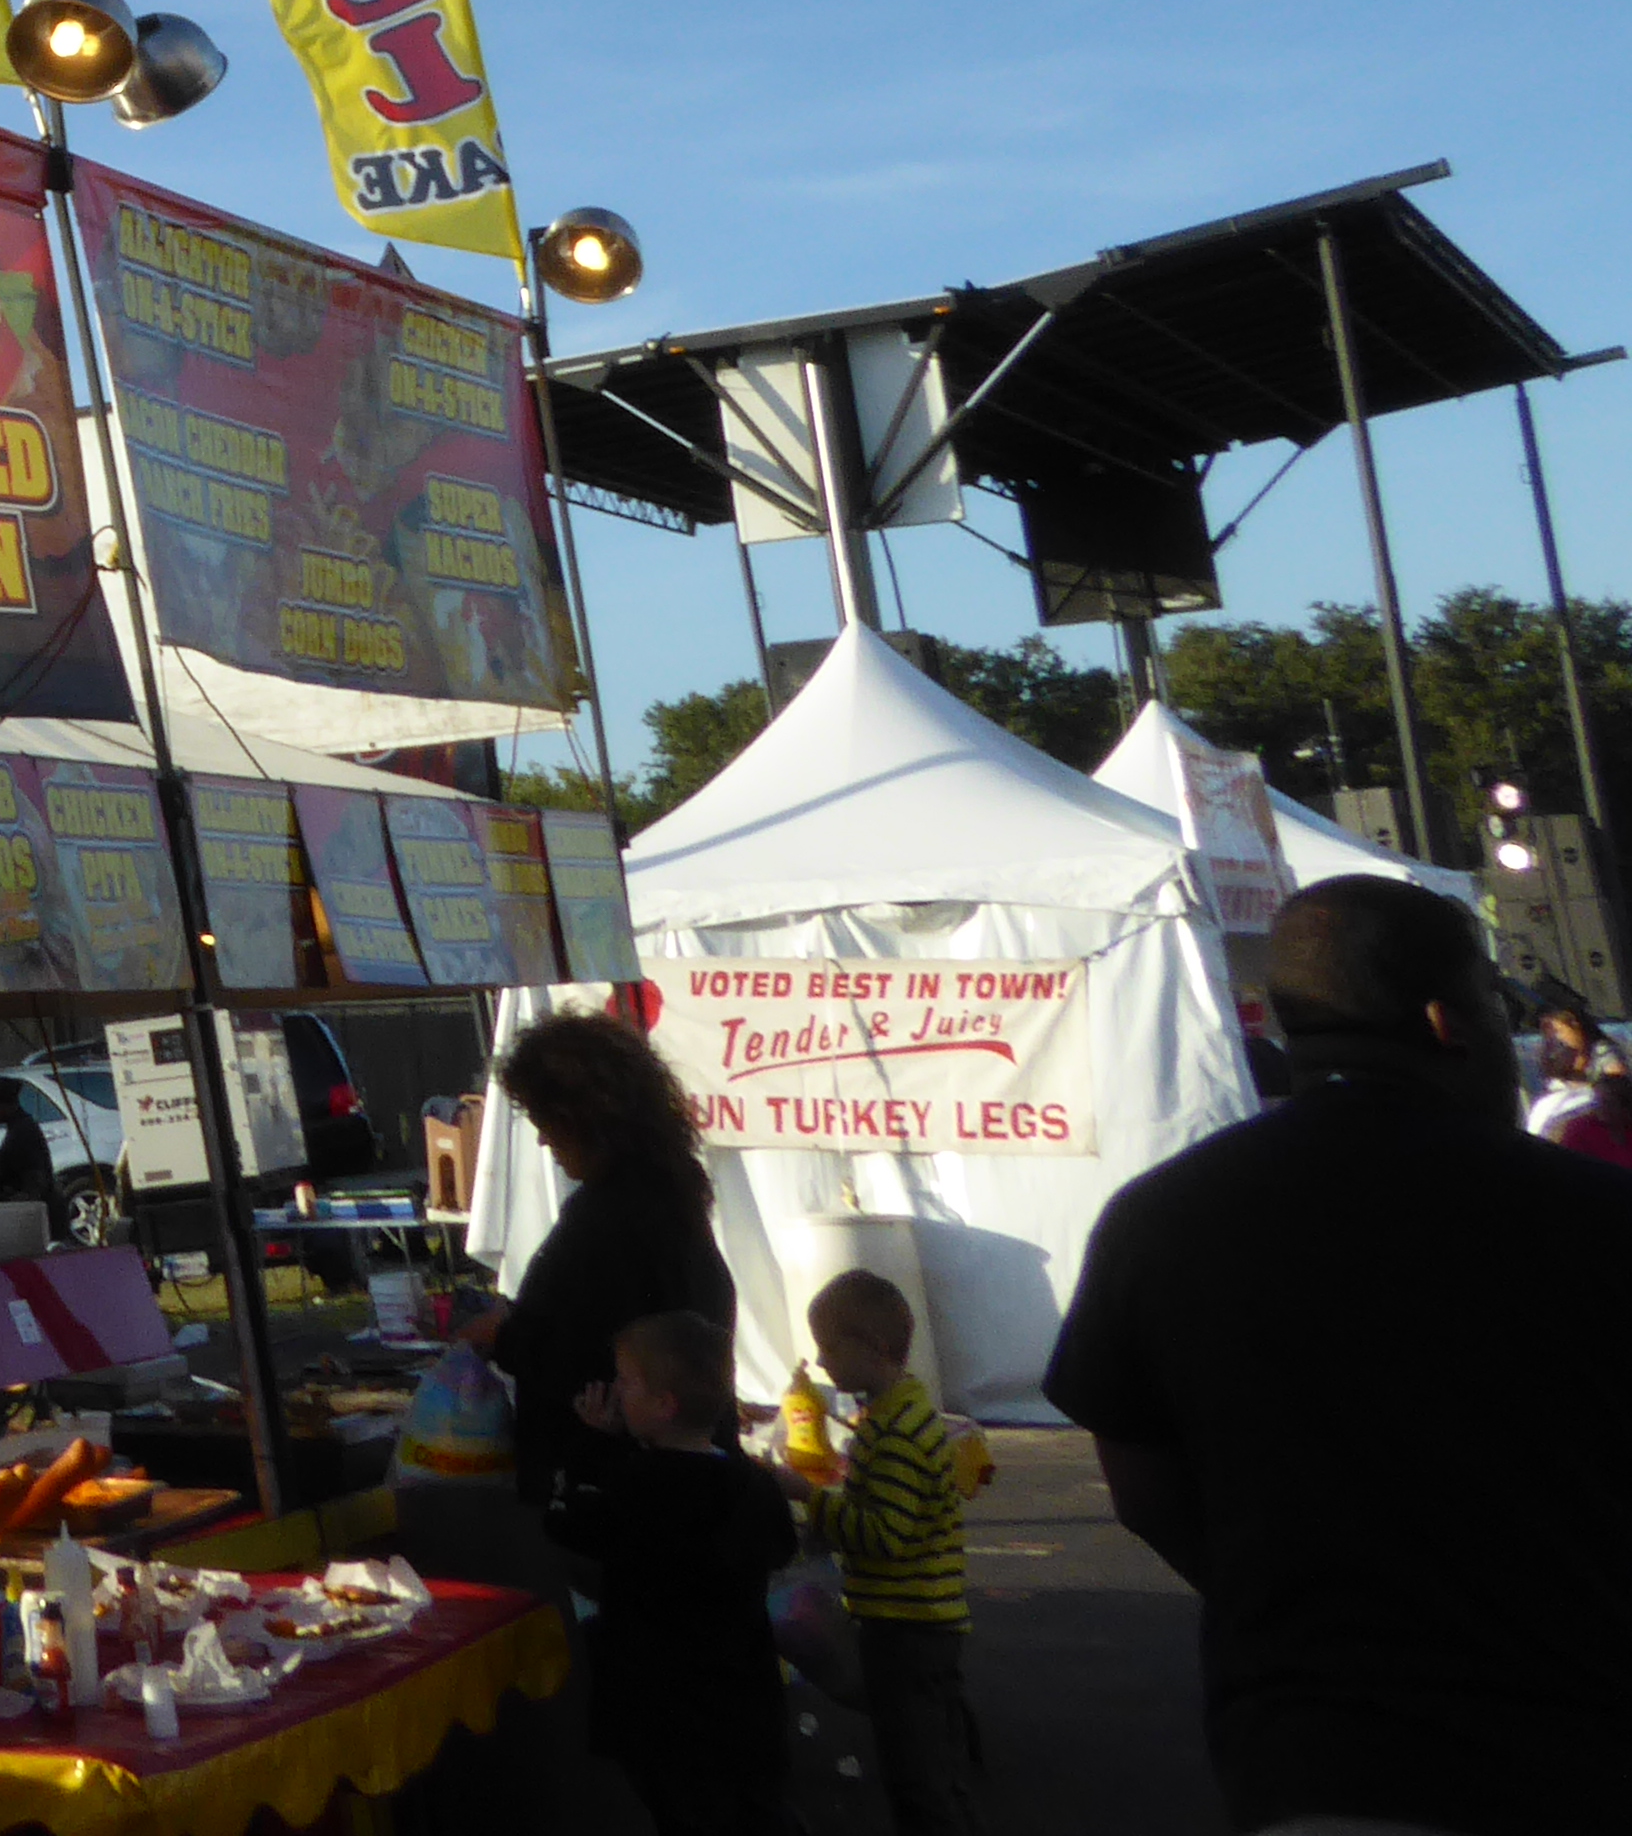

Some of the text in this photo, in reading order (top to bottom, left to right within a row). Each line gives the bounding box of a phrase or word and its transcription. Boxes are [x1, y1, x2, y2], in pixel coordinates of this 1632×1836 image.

[119, 207, 251, 301] ALLIGATOR
[122, 269, 255, 364] ON-A-STICK
[427, 478, 504, 534] SUPER
[280, 607, 405, 671] CORN DOGS
[48, 785, 157, 840] CHICKEN
[689, 970, 1068, 1001] VOTED BEST IN TOWN!
[720, 1005, 1003, 1069] Tender & Juicy
[689, 1094, 1071, 1142] UN TURKEY LEGS
